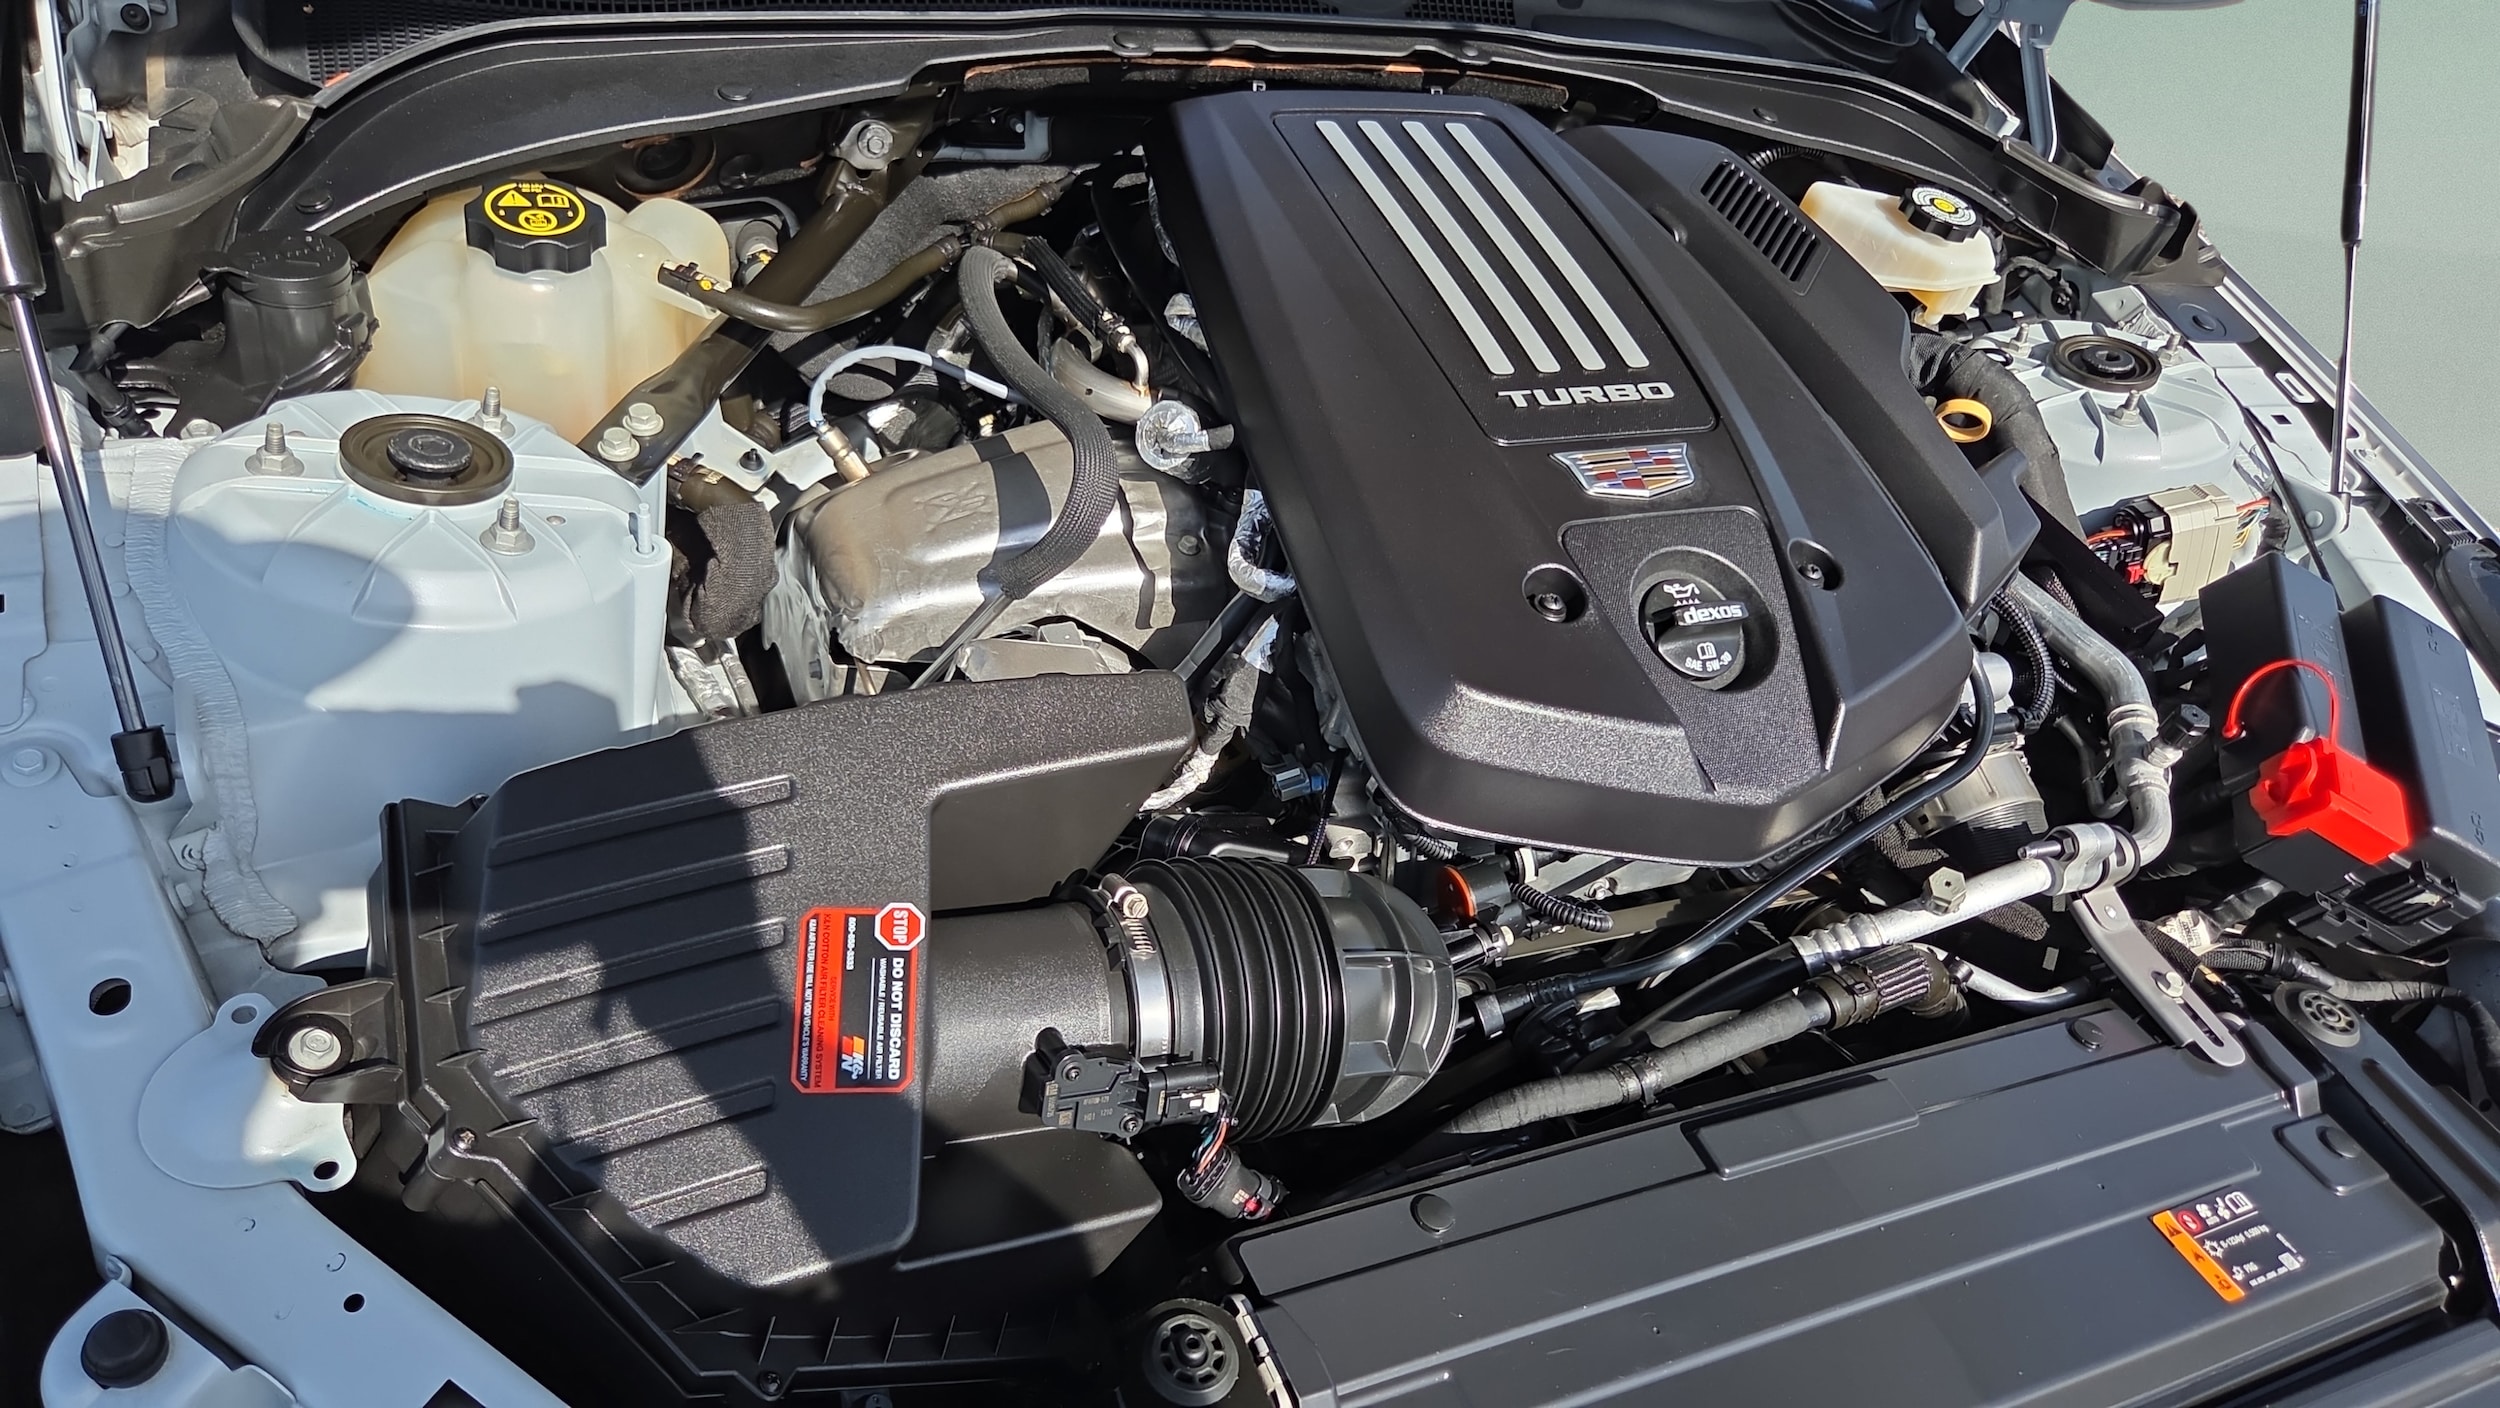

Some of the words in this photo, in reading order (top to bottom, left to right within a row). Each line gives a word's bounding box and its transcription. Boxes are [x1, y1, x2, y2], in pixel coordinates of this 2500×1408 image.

[1496, 382, 1674, 408] TURBO
[1684, 605, 1742, 624] dexos
[1685, 657, 1703, 671] SAE
[1706, 652, 1732, 672] 5W-30
[893, 910, 908, 944] STOP
[820, 931, 829, 964] COTTON
[877, 957, 887, 997] WASHABLE
[892, 958, 904, 978] DO
[804, 988, 812, 1001] NOT
[818, 981, 826, 1008] FILTER
[829, 976, 837, 1003] SERVICE
[890, 980, 903, 1010] NOT
[803, 1001, 811, 1015] VOID
[875, 1002, 884, 1039] REUSABLE
[815, 1010, 825, 1052] CLEANING
[888, 1014, 902, 1080] DISCARD
[799, 1047, 808, 1081] WARRANTY
[813, 1053, 822, 1087] SYSTEM
[874, 1055, 882, 1079] FILTER
